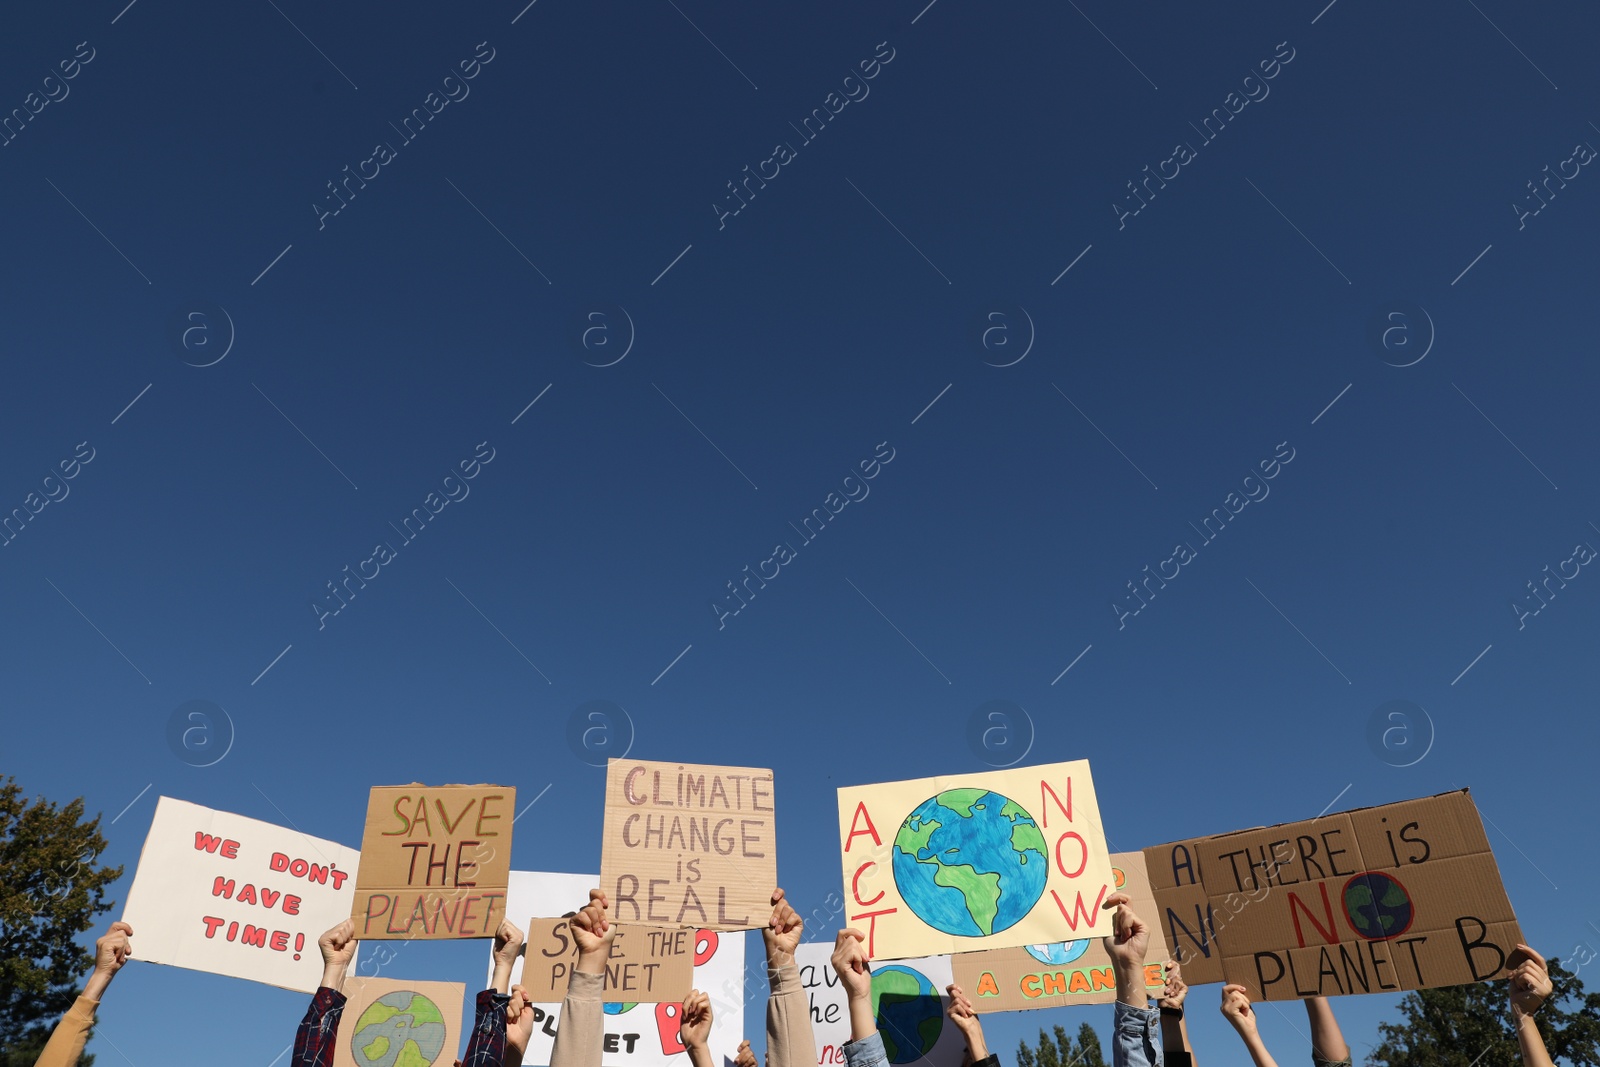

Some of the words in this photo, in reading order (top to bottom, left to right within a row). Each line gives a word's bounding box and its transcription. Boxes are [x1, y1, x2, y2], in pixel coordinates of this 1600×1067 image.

[382, 795, 504, 838] SAVE
[622, 813, 766, 858] CHANGE
[194, 831, 241, 859] WE
[269, 852, 348, 890] DON'T
[401, 840, 481, 888] THE
[1041, 776, 1107, 931] NOW
[1218, 829, 1355, 893] THERE
[212, 876, 302, 915] HAVE
[614, 873, 749, 925] REAL
[845, 801, 897, 958] ACT
[364, 892, 505, 936] PLANET
[202, 915, 305, 961] TIME!
[541, 922, 625, 959] SE
[647, 931, 688, 957] THE
[1254, 936, 1428, 1000] PLANET
[1455, 916, 1506, 982] B
[977, 971, 999, 996] A
[1020, 964, 1164, 998] CHANE
[809, 992, 842, 1023] he
